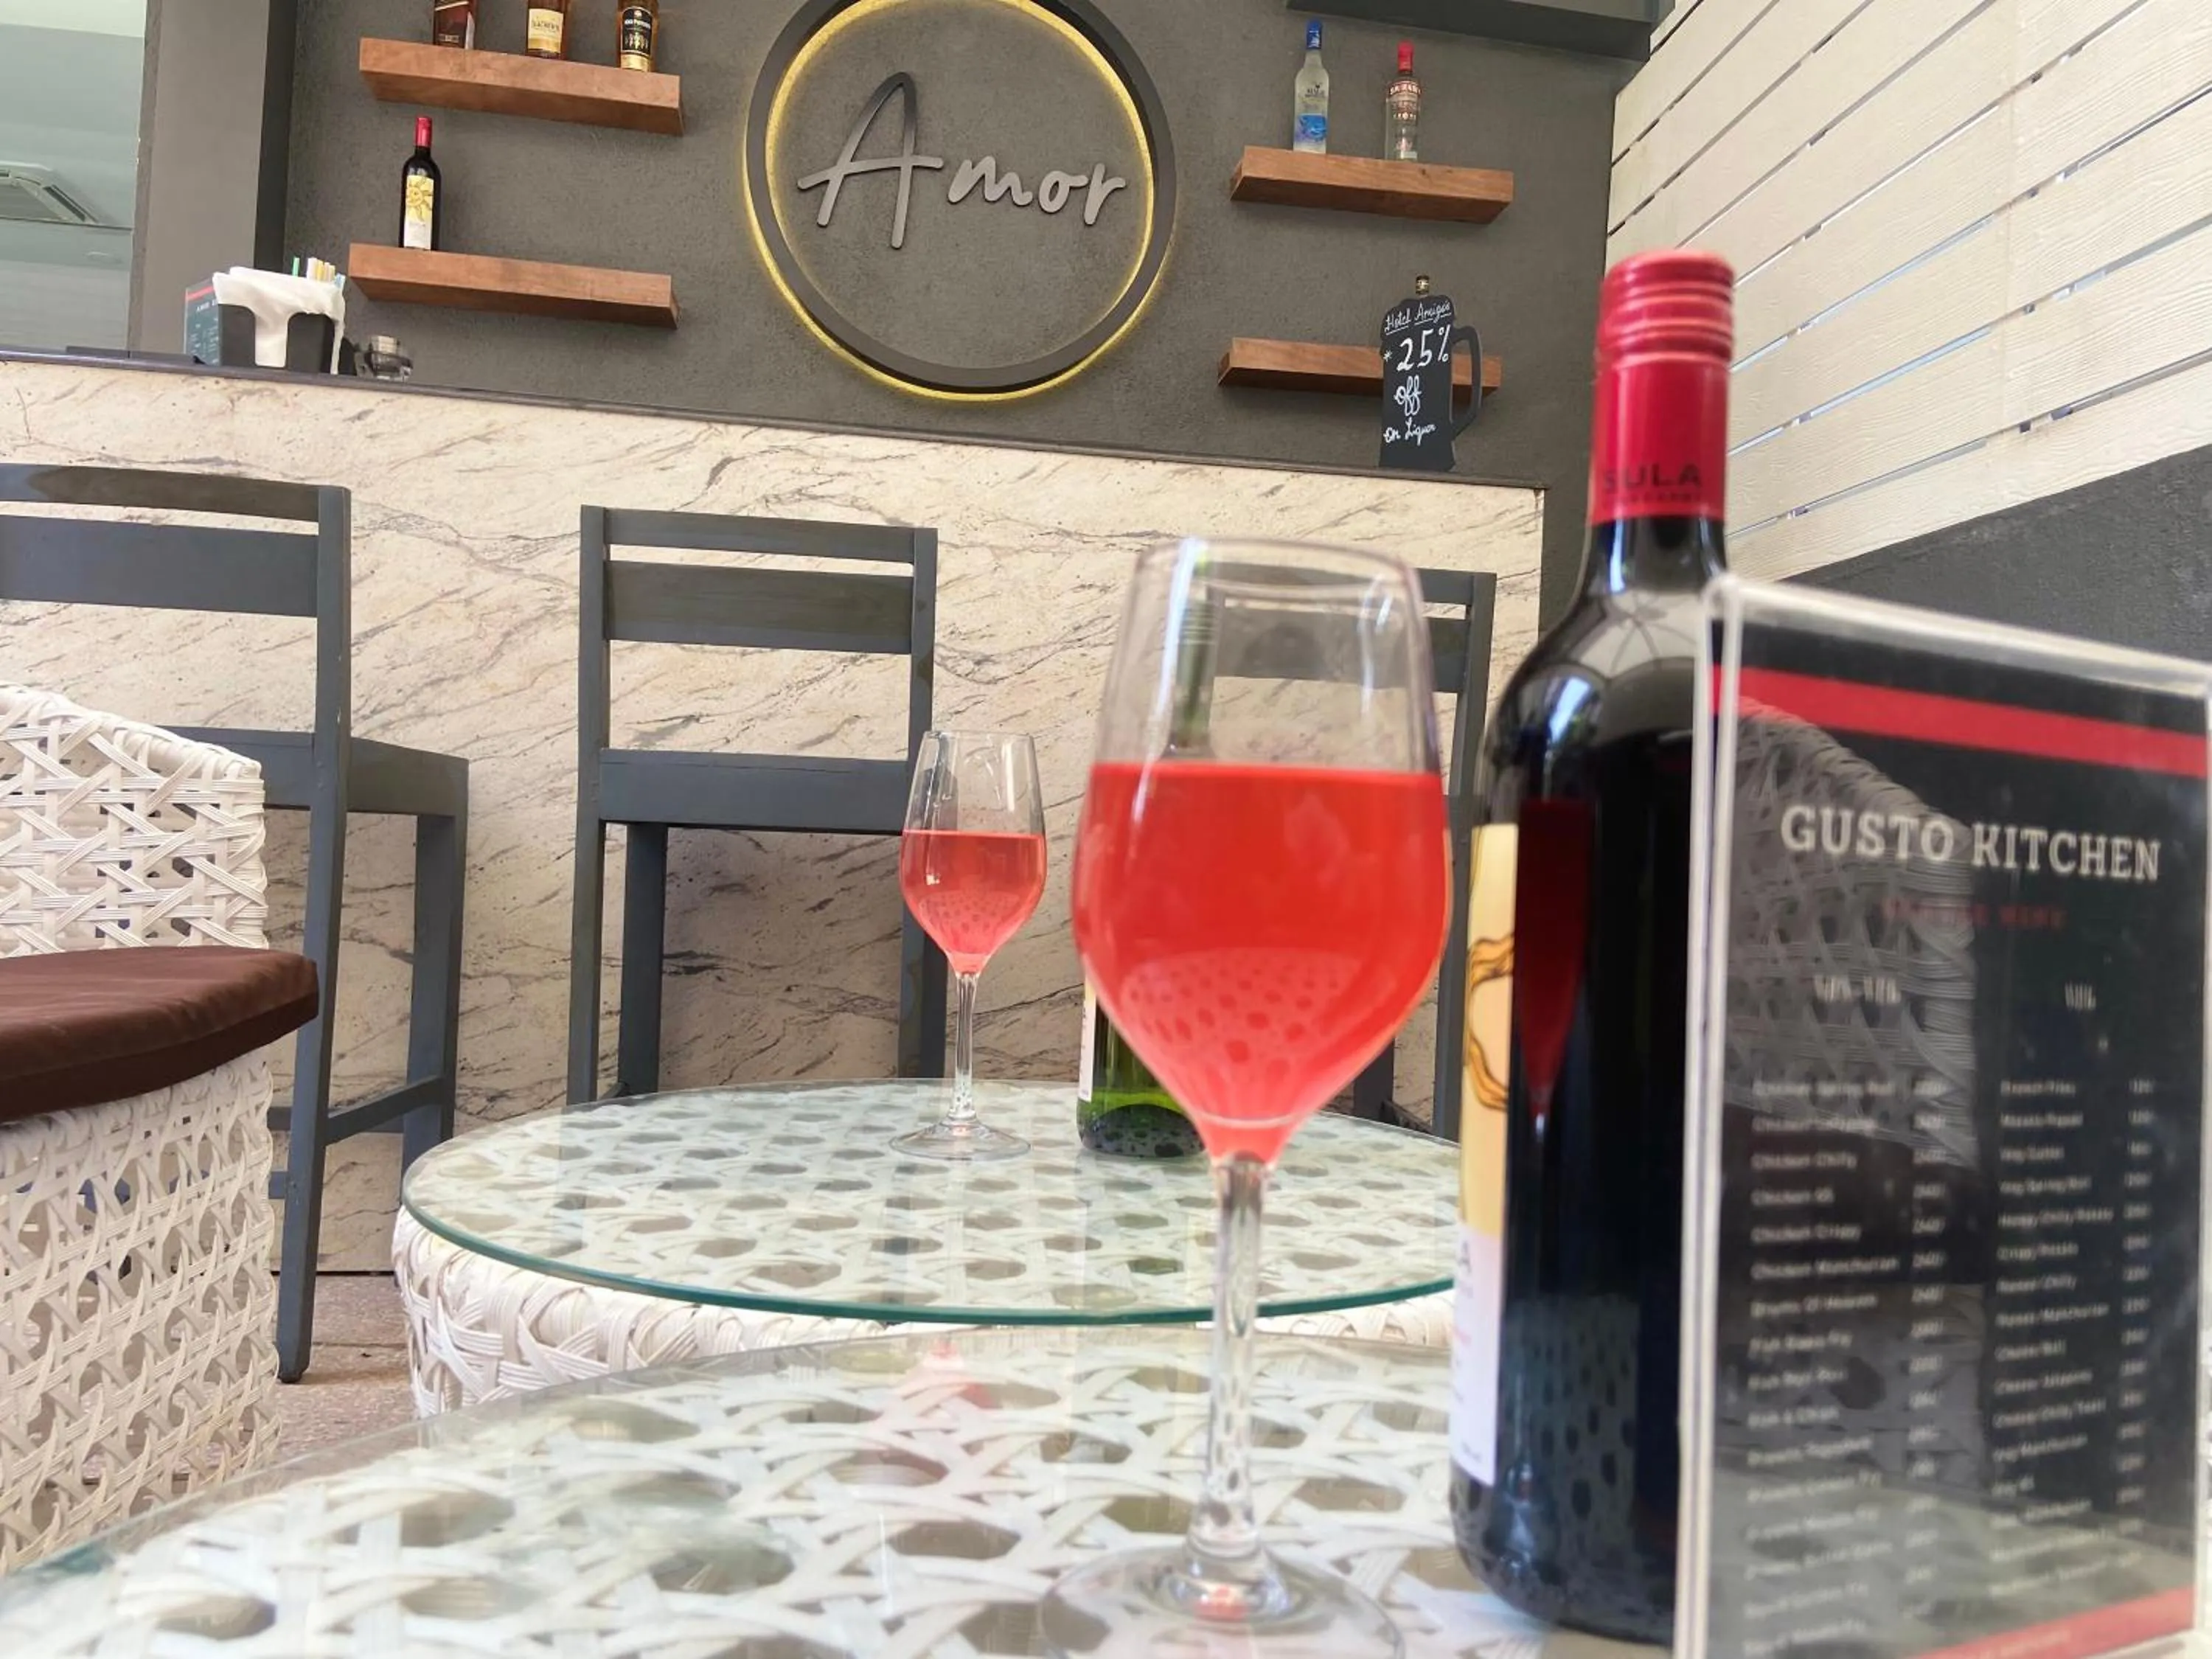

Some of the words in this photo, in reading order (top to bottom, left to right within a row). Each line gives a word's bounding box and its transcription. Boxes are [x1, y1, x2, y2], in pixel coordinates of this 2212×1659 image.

[797, 72, 1127, 249] Amor
[1385, 307, 1411, 333] Hotel
[1397, 324, 1451, 371] 25%
[1781, 804, 1954, 862] GUSTO
[1972, 822, 2161, 882] KITCHEN
